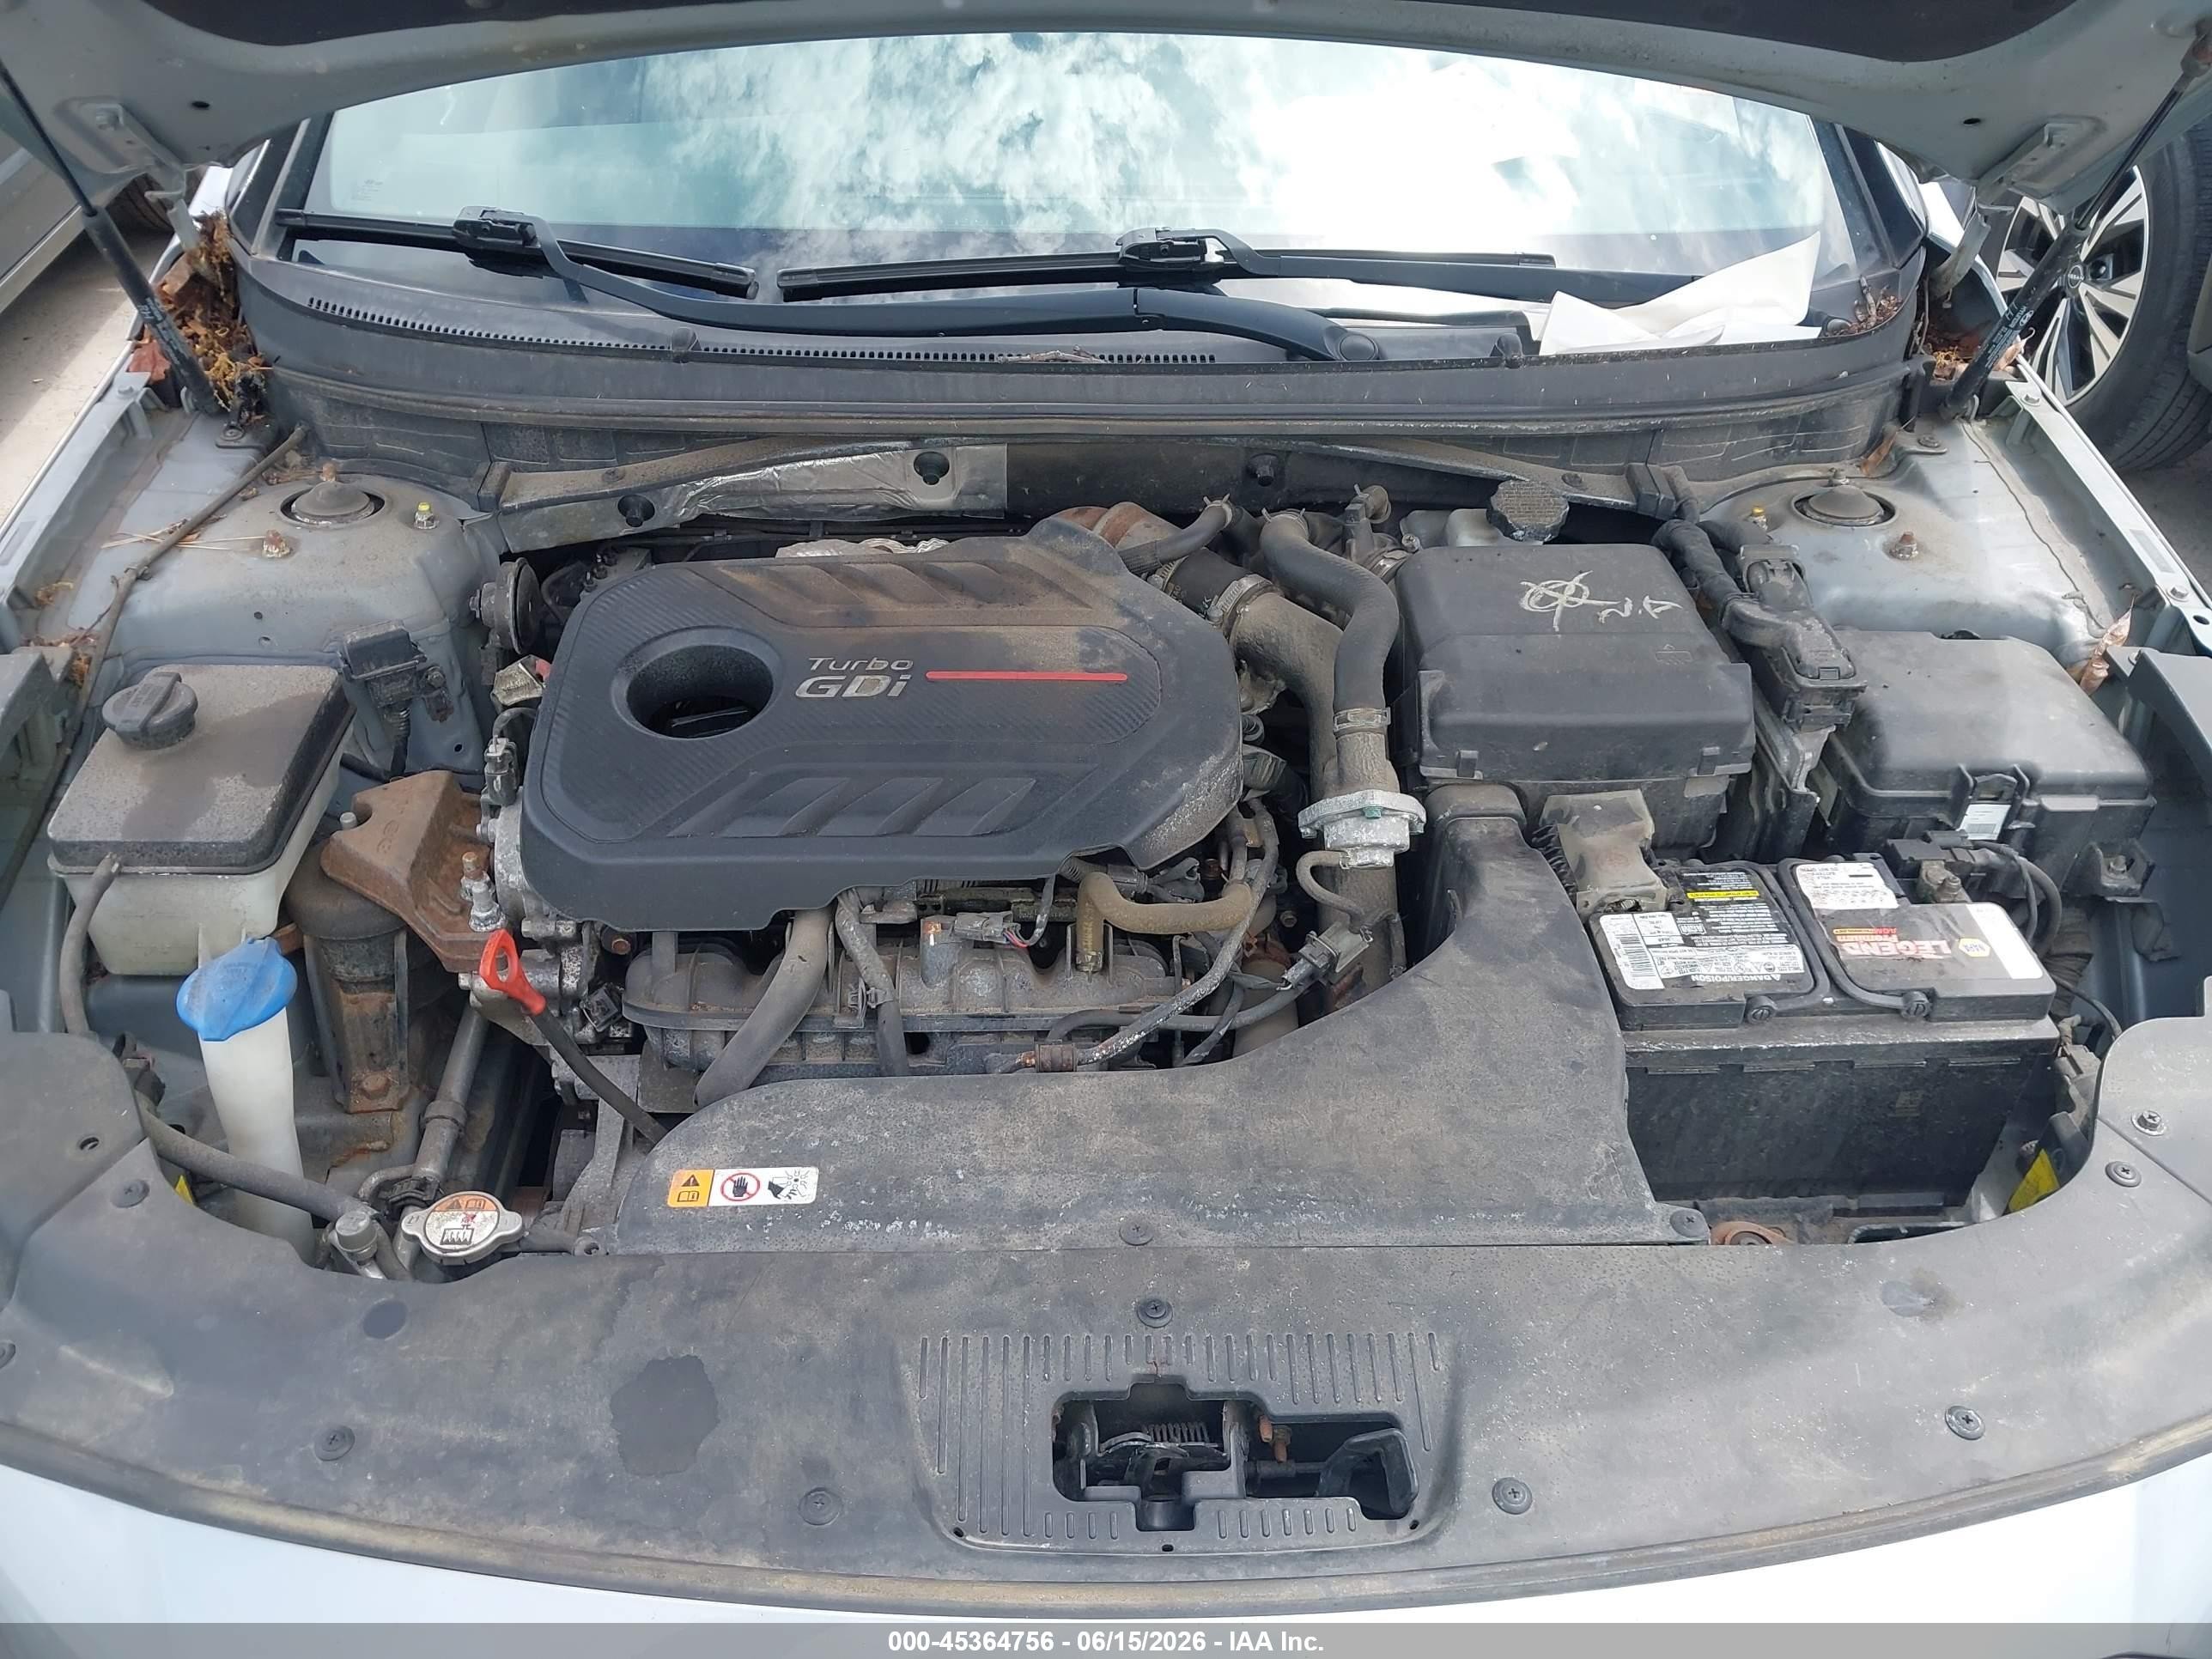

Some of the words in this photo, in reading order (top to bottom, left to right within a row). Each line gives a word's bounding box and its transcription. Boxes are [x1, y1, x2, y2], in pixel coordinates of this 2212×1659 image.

[807, 656, 915, 672] Turbo
[795, 673, 912, 698] GDi
[1840, 939, 1953, 957] LEGEND
